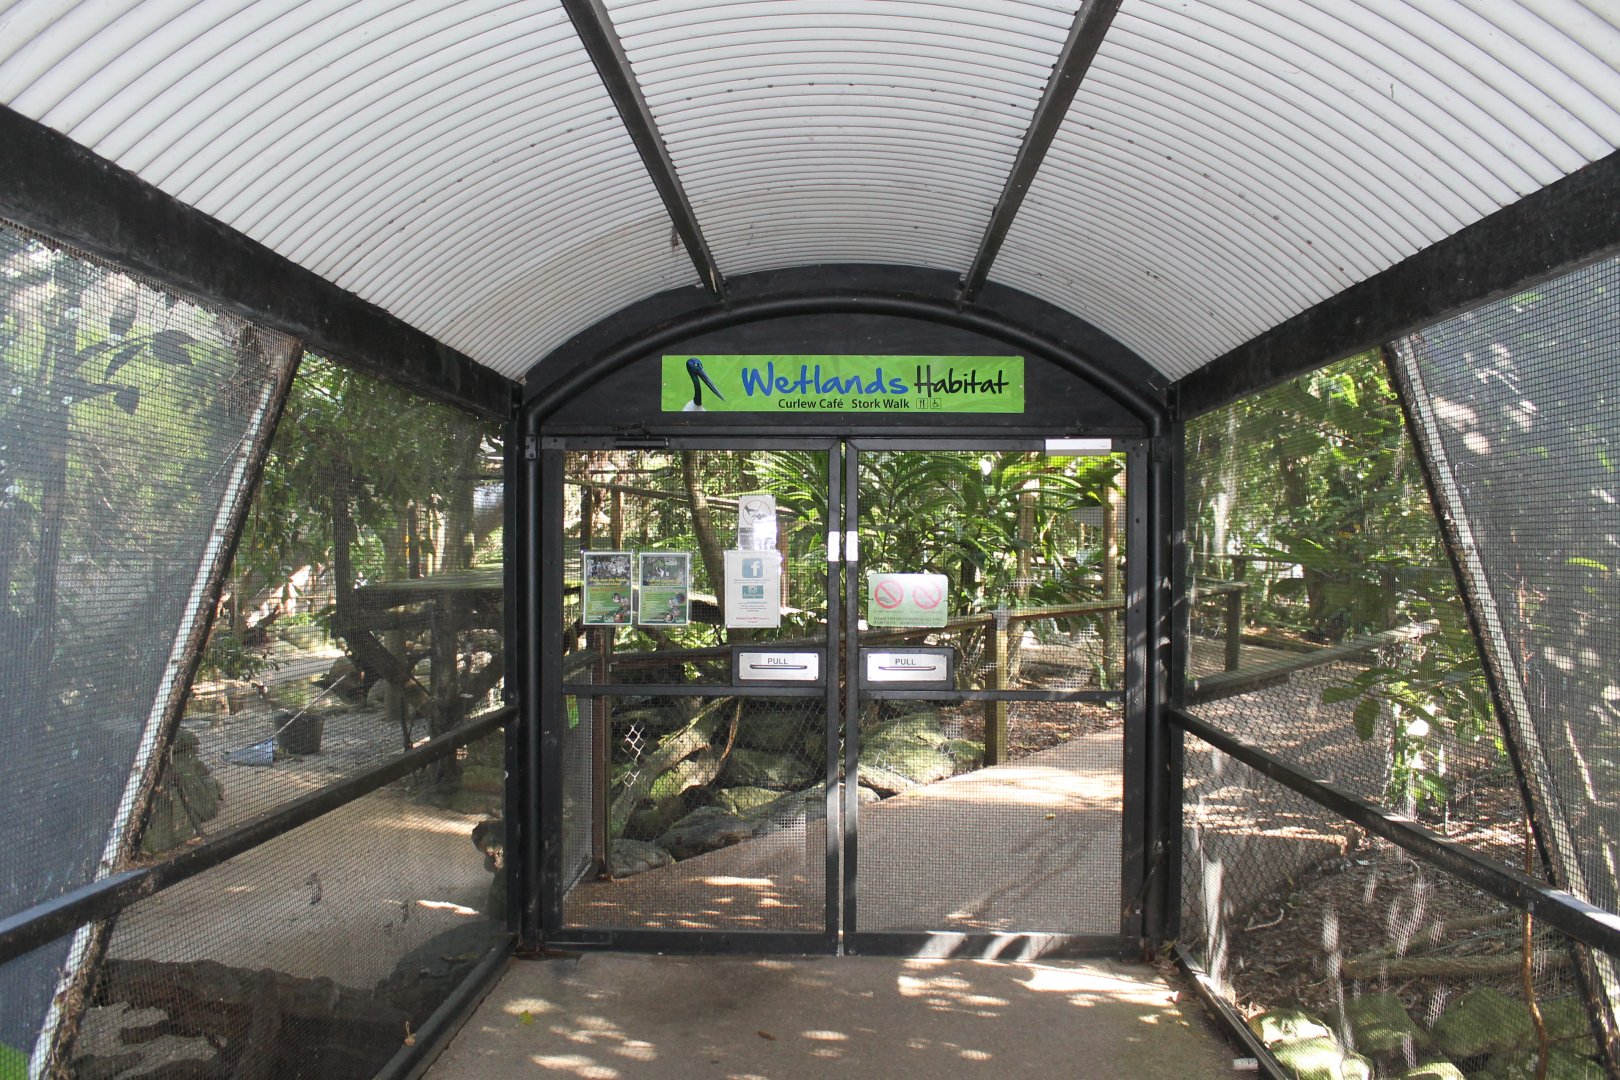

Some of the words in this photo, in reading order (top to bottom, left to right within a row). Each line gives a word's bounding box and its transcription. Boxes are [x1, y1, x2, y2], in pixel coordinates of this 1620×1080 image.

[741, 361, 909, 397] Wetlands
[914, 364, 1009, 398] Habitat
[778, 398, 816, 409] Curlew
[819, 398, 844, 409] Café
[851, 398, 881, 409] Stork
[883, 398, 910, 409] Walk
[767, 657, 789, 665] PULL
[895, 658, 916, 666] PULL
